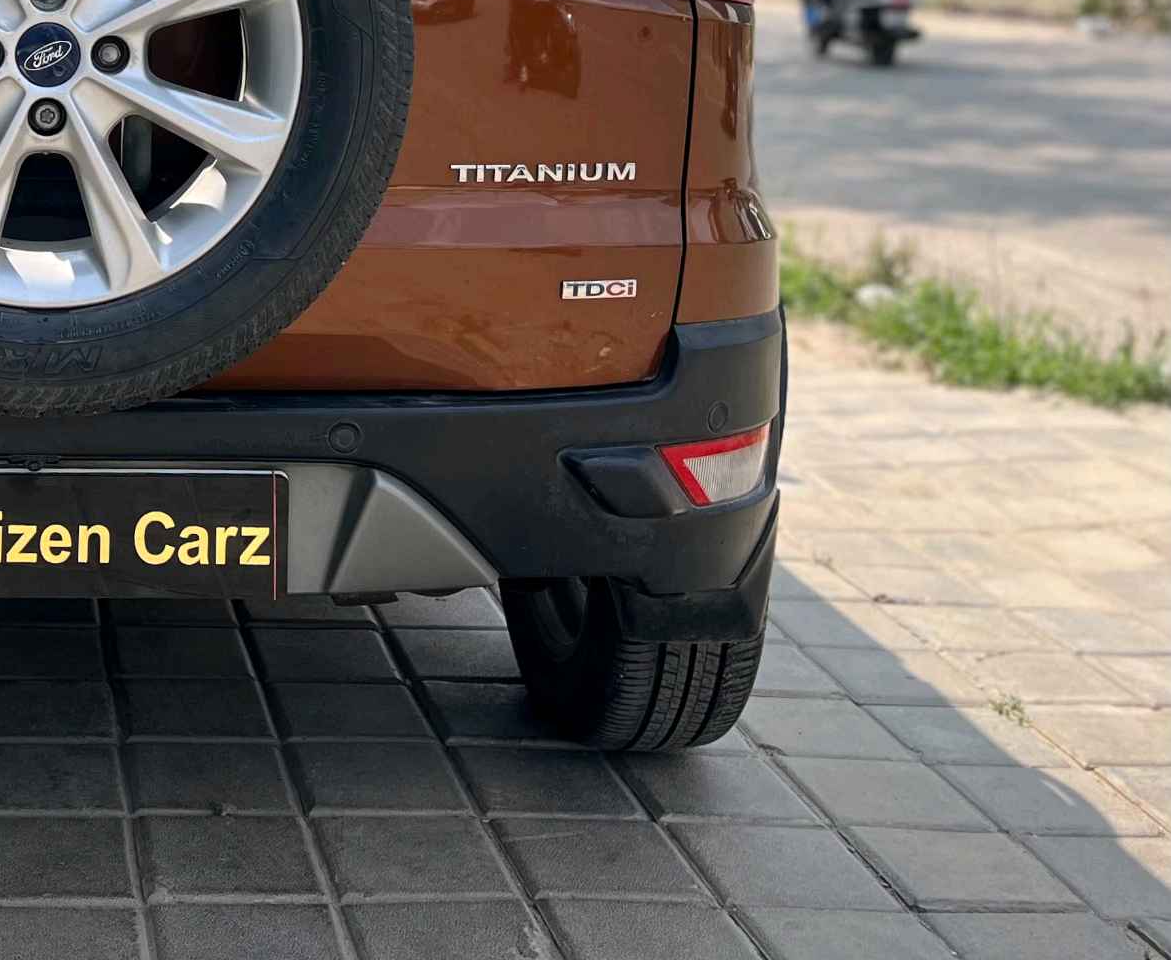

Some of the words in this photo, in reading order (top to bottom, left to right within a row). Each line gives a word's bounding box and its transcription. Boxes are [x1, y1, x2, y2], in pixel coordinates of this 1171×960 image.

[33, 45, 64, 68] Ford
[450, 162, 636, 183] TITANIUM
[566, 281, 634, 297] TDCi
[133, 511, 271, 566] Carz
